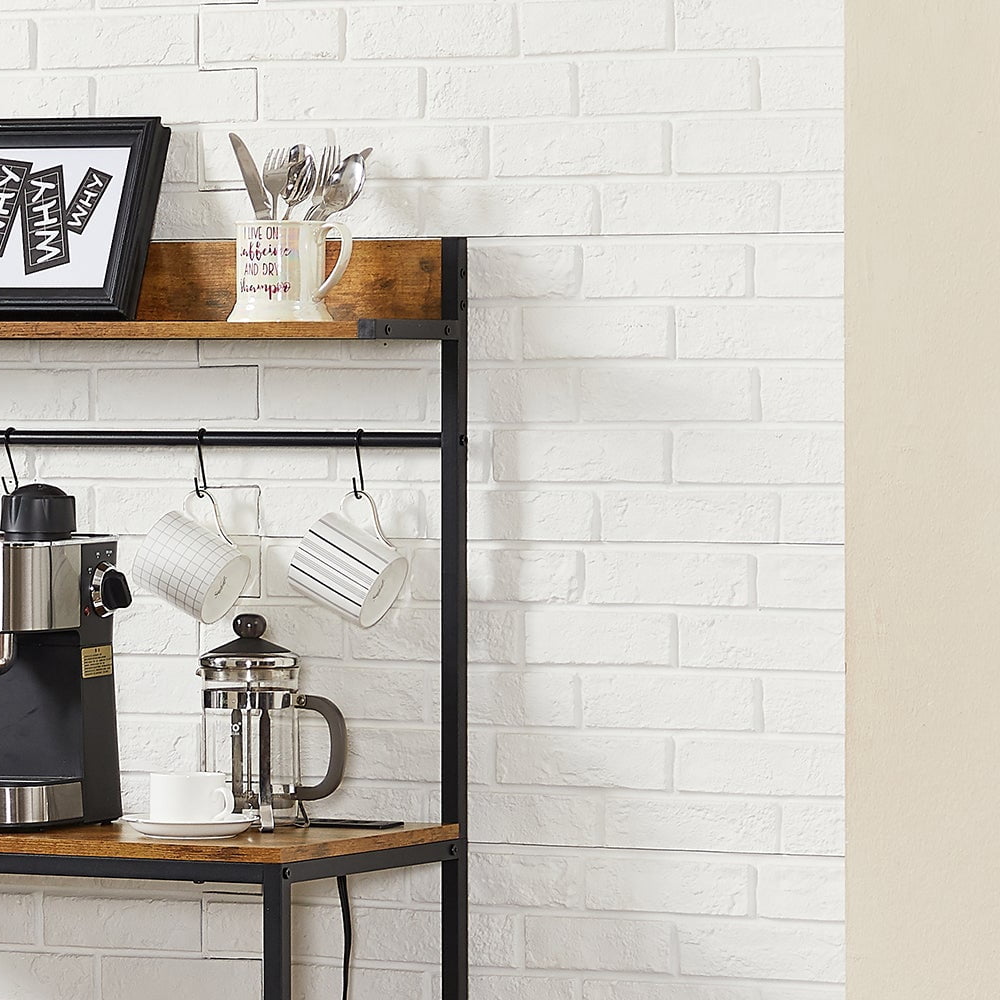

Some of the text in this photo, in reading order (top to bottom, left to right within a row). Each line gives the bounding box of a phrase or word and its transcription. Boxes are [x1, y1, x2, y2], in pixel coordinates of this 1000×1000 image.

[66, 172, 104, 228] WHY
[28, 178, 63, 264] WHY
[248, 226, 262, 240] LIVE
[265, 226, 279, 240] ON
[244, 262, 279, 276] AND DRY
